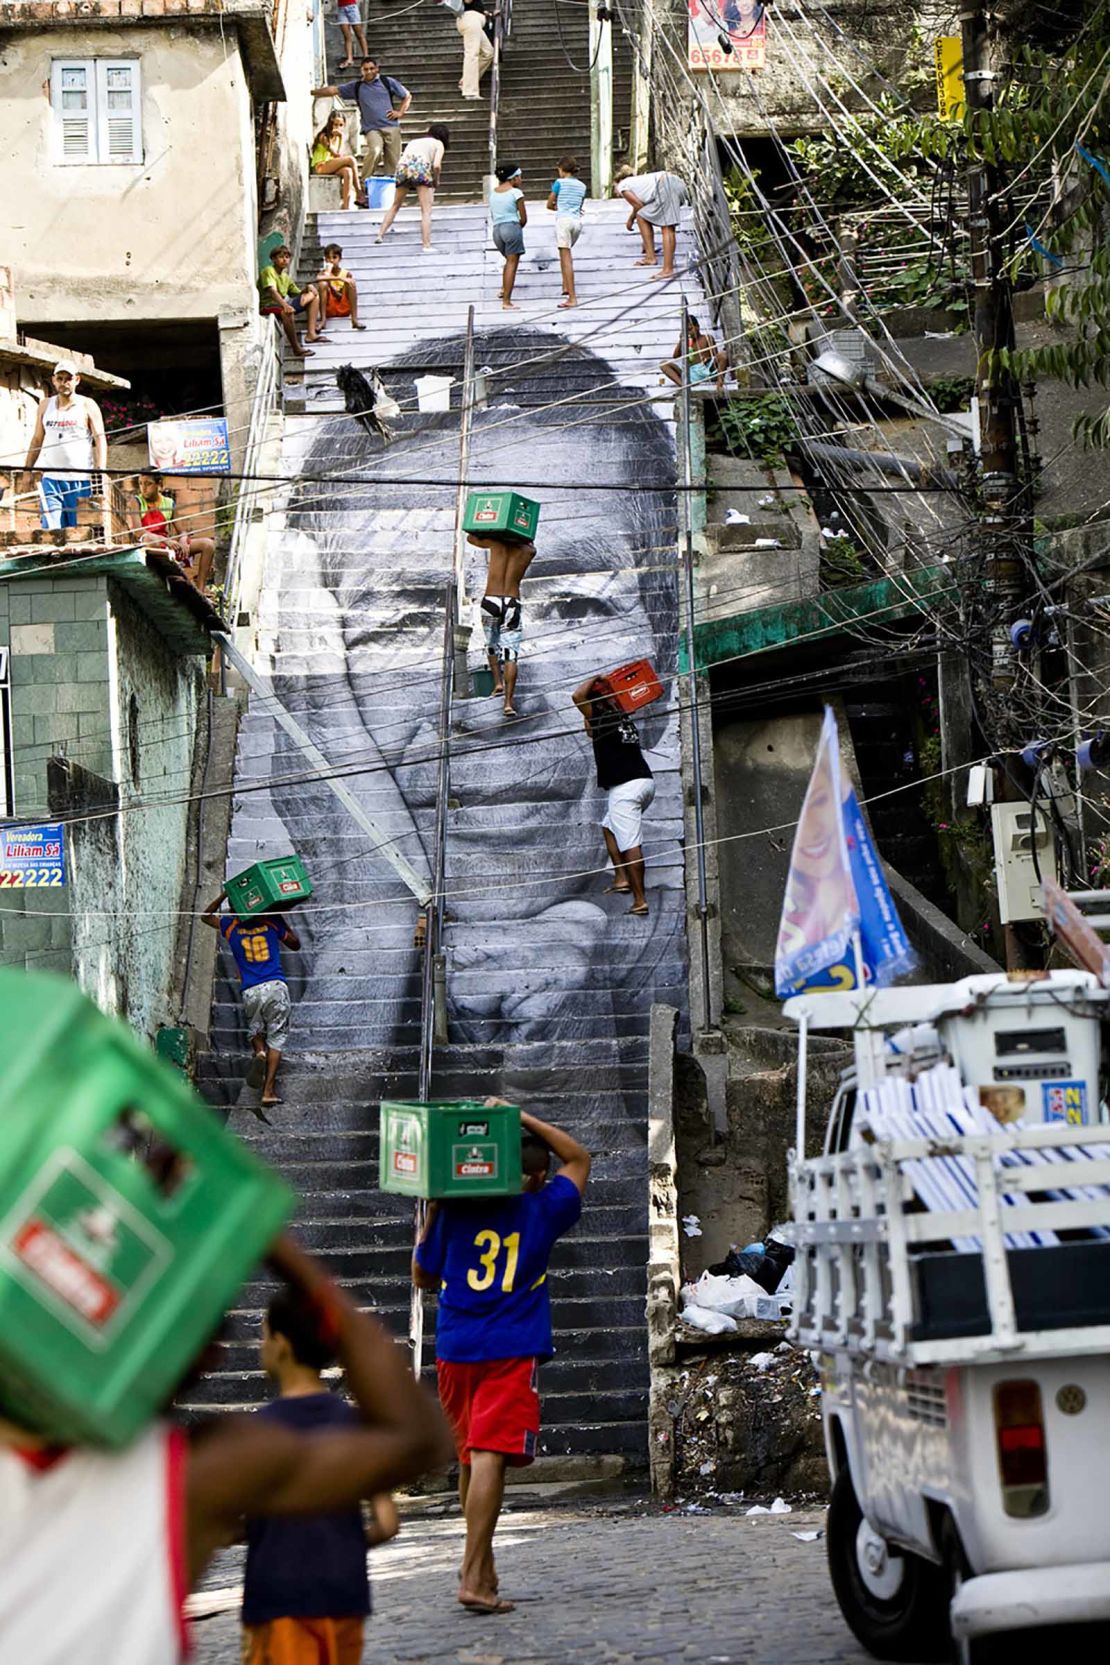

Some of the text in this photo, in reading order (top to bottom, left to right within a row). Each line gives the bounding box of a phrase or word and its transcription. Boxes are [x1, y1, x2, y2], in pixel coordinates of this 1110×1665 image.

[182, 449, 229, 467] 22222
[6, 842, 60, 858] Liliam Sá
[0, 868, 63, 888] 22222
[467, 1229, 520, 1292] 31
